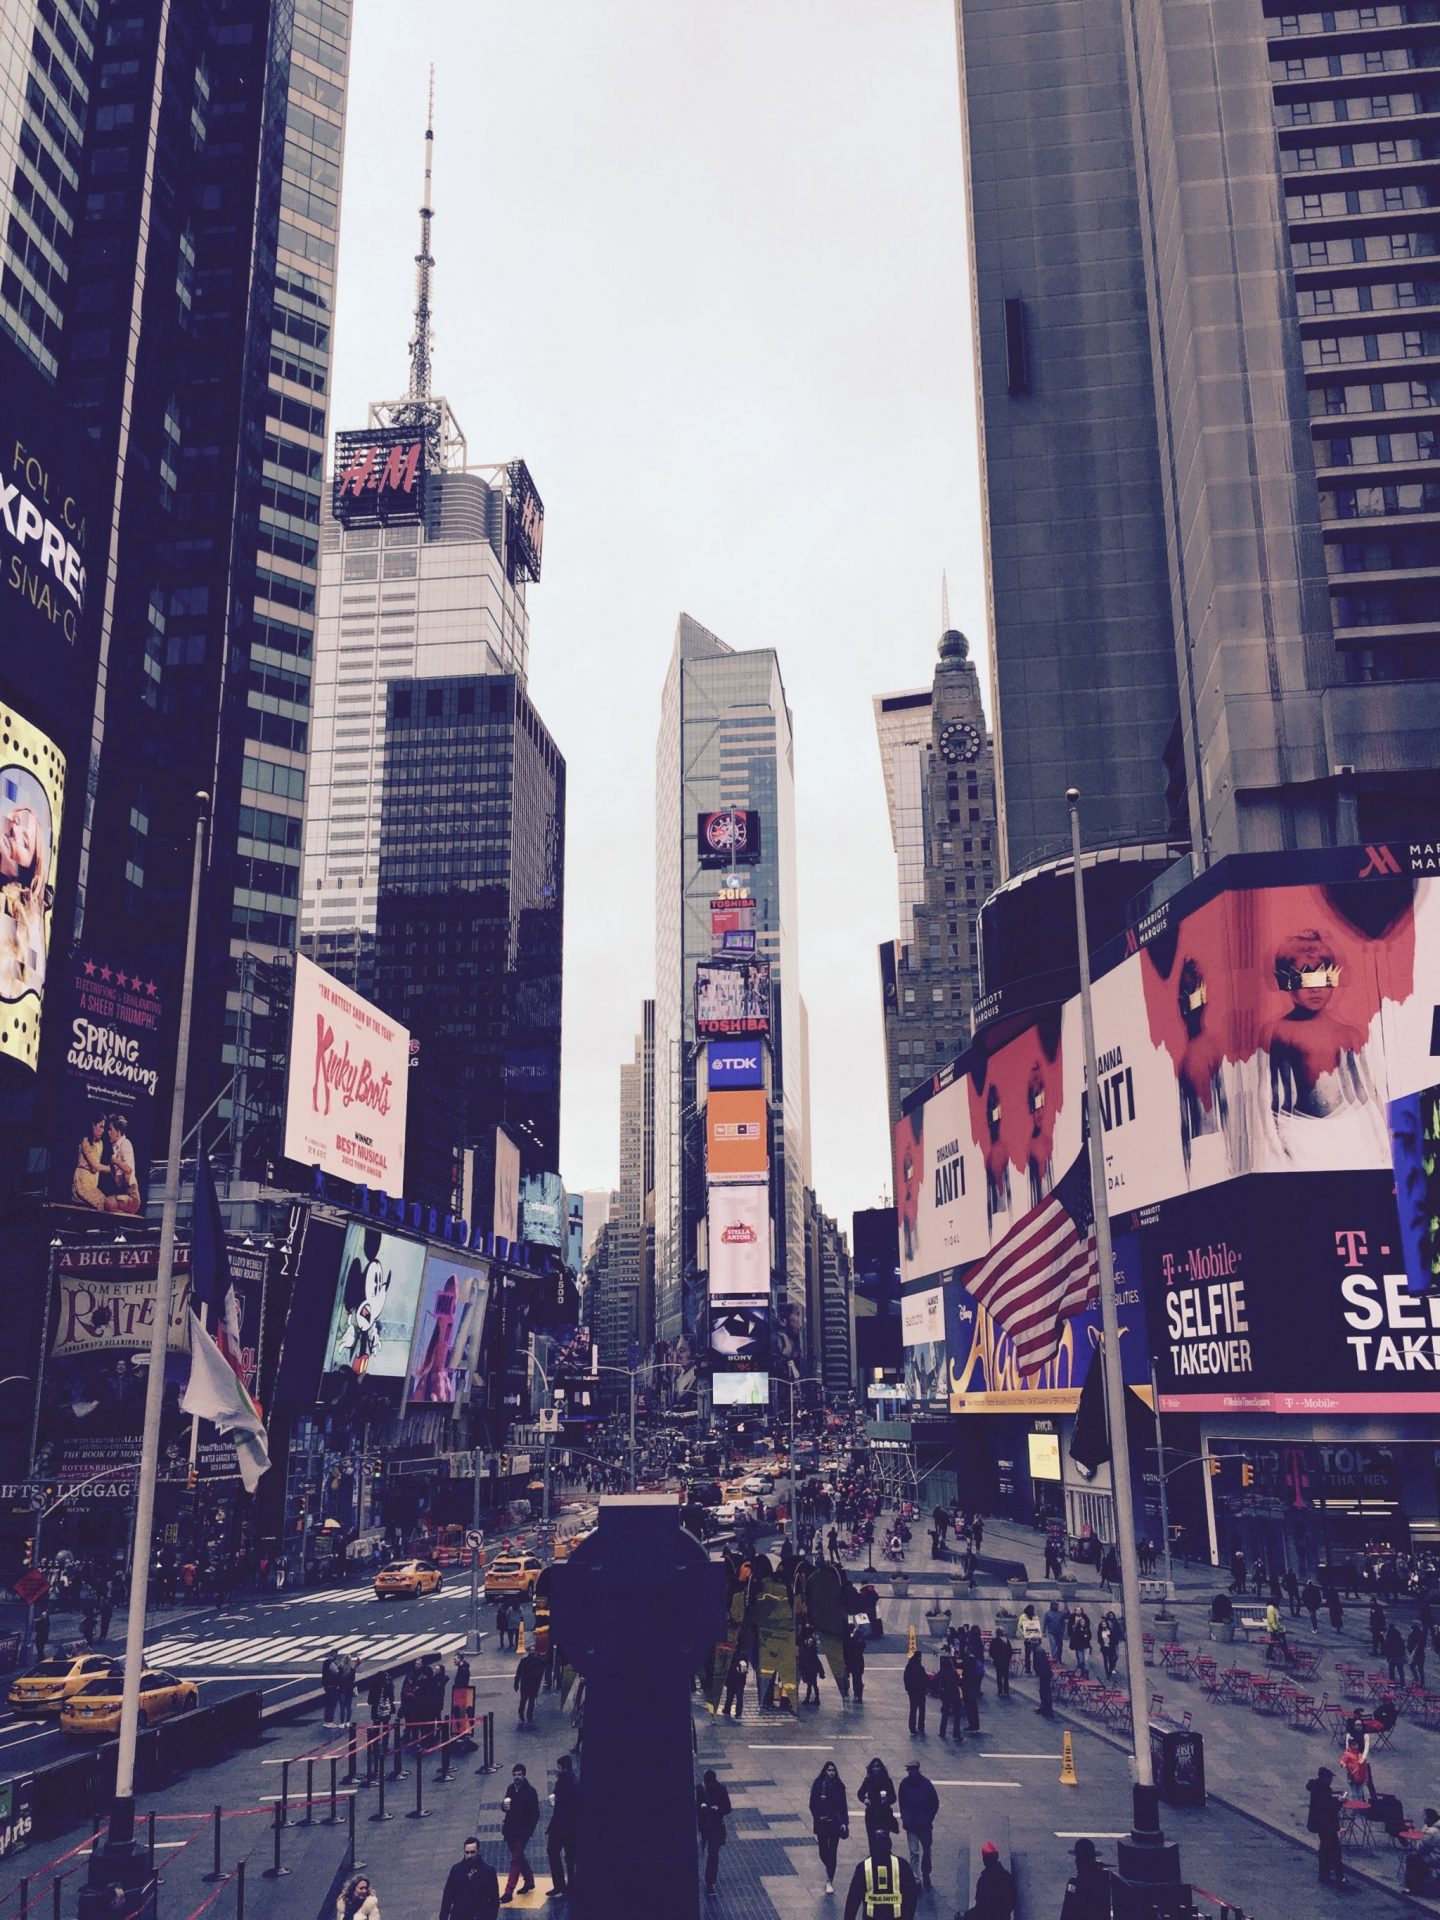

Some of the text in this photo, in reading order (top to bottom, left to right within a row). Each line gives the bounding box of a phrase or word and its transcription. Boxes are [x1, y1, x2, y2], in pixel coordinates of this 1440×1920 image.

[339, 444, 422, 496] H&M
[712, 900, 756, 908] TOSHIBA
[718, 888, 748, 900] 2016
[1138, 902, 1170, 932] MARRIOTT
[1139, 918, 1168, 945] MARQUIS
[88, 994, 113, 1017] SHEER
[372, 1018, 381, 1035] THE
[699, 1019, 769, 1032] TOSHIBA
[72, 1017, 140, 1062] SPRING
[67, 1048, 160, 1096] awakening
[312, 1012, 392, 1116] Kinky Boots
[722, 1058, 757, 1069] TDK
[1084, 1046, 1122, 1084] ANNA
[336, 1134, 357, 1156] BEST
[358, 1144, 387, 1169] MUSICAL
[937, 1139, 959, 1164] RIHANNA
[354, 1160, 366, 1173] TONY
[935, 1156, 966, 1208] ANTI
[1108, 1174, 1126, 1190] DAL
[944, 1233, 960, 1247] TIDAL
[120, 1250, 152, 1264] FAT
[158, 1249, 190, 1263] IT
[78, 1280, 177, 1296] SOMETHIG
[1166, 1280, 1249, 1340] SELFIE
[1341, 1274, 1440, 1330] SE
[1170, 1339, 1253, 1376] TAKEOVER
[1347, 1336, 1440, 1371] TAK
[57, 1484, 142, 1498] LUGGAG
[1176, 1744, 1194, 1757] JERSEY
